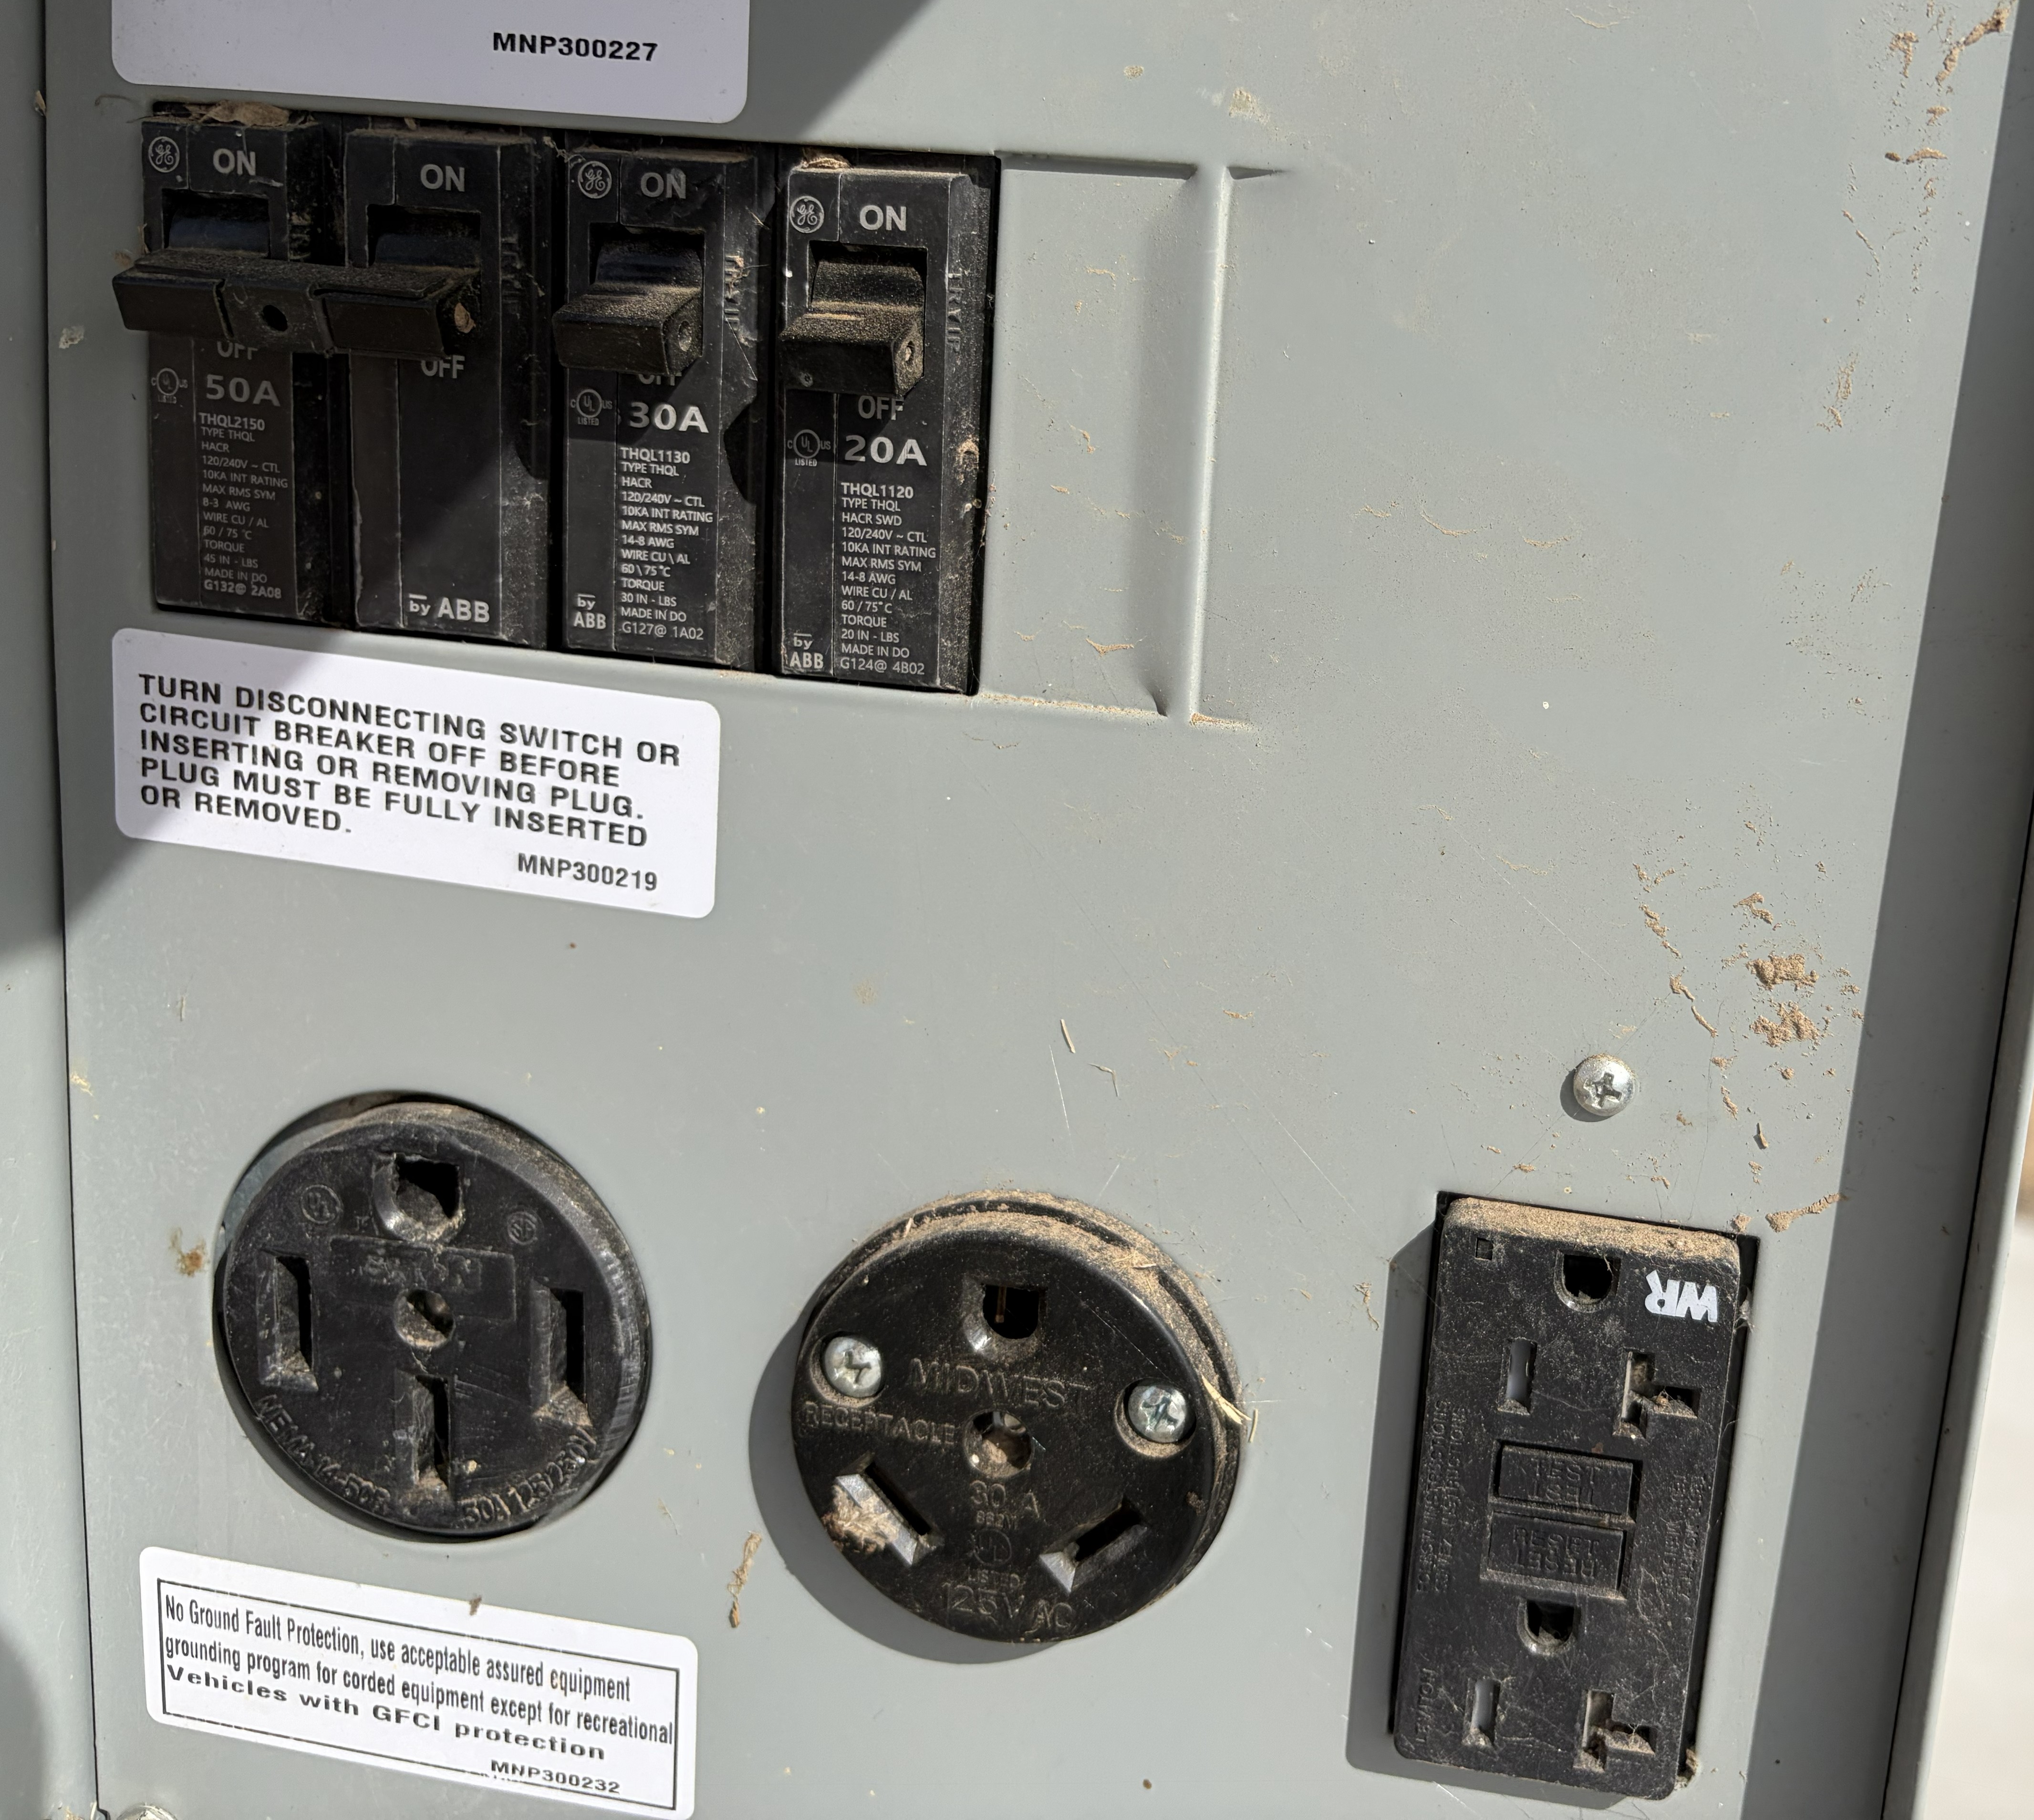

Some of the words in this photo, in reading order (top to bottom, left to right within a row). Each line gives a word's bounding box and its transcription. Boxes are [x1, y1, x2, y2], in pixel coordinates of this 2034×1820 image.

[493, 31, 658, 62] MNP300227
[212, 148, 256, 176] ON
[420, 164, 466, 192] ON
[641, 168, 686, 199] ON
[859, 205, 906, 231] ON
[421, 355, 465, 379] OFF
[206, 374, 280, 407] 50A
[858, 395, 904, 421] OFF
[198, 412, 266, 431] THQL2150
[630, 402, 710, 434] 30A
[200, 426, 225, 439] TYPE
[228, 429, 255, 442] THQL
[201, 441, 230, 453] HACR
[620, 447, 690, 464] THQL1130
[844, 435, 927, 466] 20A
[202, 455, 248, 469] 120/240V
[262, 462, 280, 474] CTL
[621, 462, 647, 474] TYPE
[650, 464, 679, 476] THQL
[795, 458, 818, 467] LISTED
[202, 470, 227, 481] 10KA
[230, 472, 248, 483] INT
[250, 475, 288, 488] RATING
[621, 476, 653, 489] HACR
[202, 483, 226, 495] MAX
[229, 486, 251, 498] RMS
[253, 489, 276, 501] SYM
[841, 482, 913, 499] THQL1120
[225, 500, 250, 512] AWG
[622, 491, 672, 505] 120/240V
[685, 496, 706, 508] CTL
[841, 497, 867, 509] TYPE
[871, 499, 901, 512] THQL
[202, 511, 228, 524] WIRE
[231, 514, 246, 525] CU
[622, 506, 649, 517] 10KA
[652, 508, 670, 519] INT
[672, 510, 713, 523] RATING
[842, 512, 872, 524] HACR
[875, 515, 902, 526] SWD
[621, 519, 647, 532] MAX
[649, 523, 673, 534] RMS
[675, 525, 699, 536] SYM
[842, 527, 893, 540] 120/240V
[907, 531, 928, 543] CTL
[203, 539, 246, 553] TORQUE
[622, 534, 645, 546] 14-8
[648, 537, 675, 548] AWG
[621, 548, 649, 561] WIRE
[651, 551, 666, 562] CU
[676, 553, 690, 565] AL
[842, 542, 870, 554] 10KA
[873, 544, 890, 555] INT
[894, 546, 936, 558] RATING
[240, 557, 259, 569] LBS
[622, 564, 634, 574] 60
[644, 566, 657, 577] 75
[841, 556, 868, 568] MAX
[871, 558, 895, 570] RMS
[898, 560, 922, 572] SYM
[203, 568, 234, 580] MADE
[251, 572, 267, 584] DO
[842, 571, 866, 582] 14-8
[869, 573, 896, 585] AWG
[621, 578, 665, 592] TORQUE
[841, 585, 869, 598] WIRE
[872, 588, 888, 599] CU
[899, 589, 913, 601] AL
[577, 598, 596, 610] by
[621, 593, 634, 603] 30
[636, 594, 648, 605] IN
[658, 596, 677, 608] LBS
[841, 600, 855, 611] 60
[410, 600, 431, 616] by
[438, 597, 490, 623] ABB
[621, 607, 652, 620] MADE
[655, 609, 667, 620] IN
[670, 610, 686, 622] DO
[573, 611, 606, 630] ABB
[841, 614, 887, 628] TORQUE
[622, 621, 667, 638] G127@
[673, 626, 704, 641] 1A02
[841, 629, 854, 640] 20
[858, 630, 870, 641] IN
[881, 632, 899, 643] LBS
[794, 636, 812, 650] by
[841, 643, 874, 656] MADE
[877, 645, 889, 657] IN
[892, 647, 910, 659] DO
[789, 651, 824, 669] ABB
[840, 657, 887, 673] G124@
[892, 660, 925, 675] 4B02
[138, 673, 221, 705] TURN
[236, 685, 486, 741] DISCONNECTING
[500, 722, 623, 759] SWITCH
[637, 741, 680, 766] OR
[140, 703, 261, 737] CIRCUIT
[275, 719, 415, 759] BREAKER
[428, 741, 486, 767] OFF
[500, 751, 620, 788] BEFORE
[141, 729, 304, 772] INSERTING
[317, 754, 359, 780] OR
[373, 761, 536, 804] REMOVING
[551, 786, 643, 820] PLUG.
[141, 757, 219, 788] PLUG
[233, 769, 321, 800] MUST
[334, 784, 371, 808] BE
[385, 790, 480, 823] FULLY
[494, 806, 648, 848] INSERTED
[141, 785, 181, 809] OR
[195, 791, 352, 834] REMOVED.
[518, 853, 658, 891] MNP300219
[1645, 1270, 1717, 1323] WR
[909, 1357, 1091, 1409] MIDWEST
[805, 1400, 955, 1445] RECEPTACLE
[969, 1479, 1006, 1507] 30
[166, 1594, 184, 1622] No
[189, 1599, 239, 1633] Ground
[246, 1609, 282, 1641] Fault
[288, 1617, 364, 1659] Protection,
[371, 1637, 395, 1661] use
[401, 1644, 480, 1677] acceptable
[487, 1657, 544, 1687] assured
[550, 1667, 631, 1702] equipment
[166, 1636, 240, 1672] grounding
[248, 1651, 311, 1681] program
[317, 1660, 338, 1686] for
[342, 1670, 395, 1697] corded
[402, 1680, 484, 1712] equipment
[490, 1696, 542, 1726] except
[549, 1702, 570, 1727] for
[576, 1711, 673, 1745] recreational
[167, 1664, 288, 1702] Vehicles
[300, 1693, 359, 1716] with
[373, 1704, 440, 1731] GFCI
[455, 1722, 605, 1760] protection
[490, 1759, 621, 1794] MNP300232
